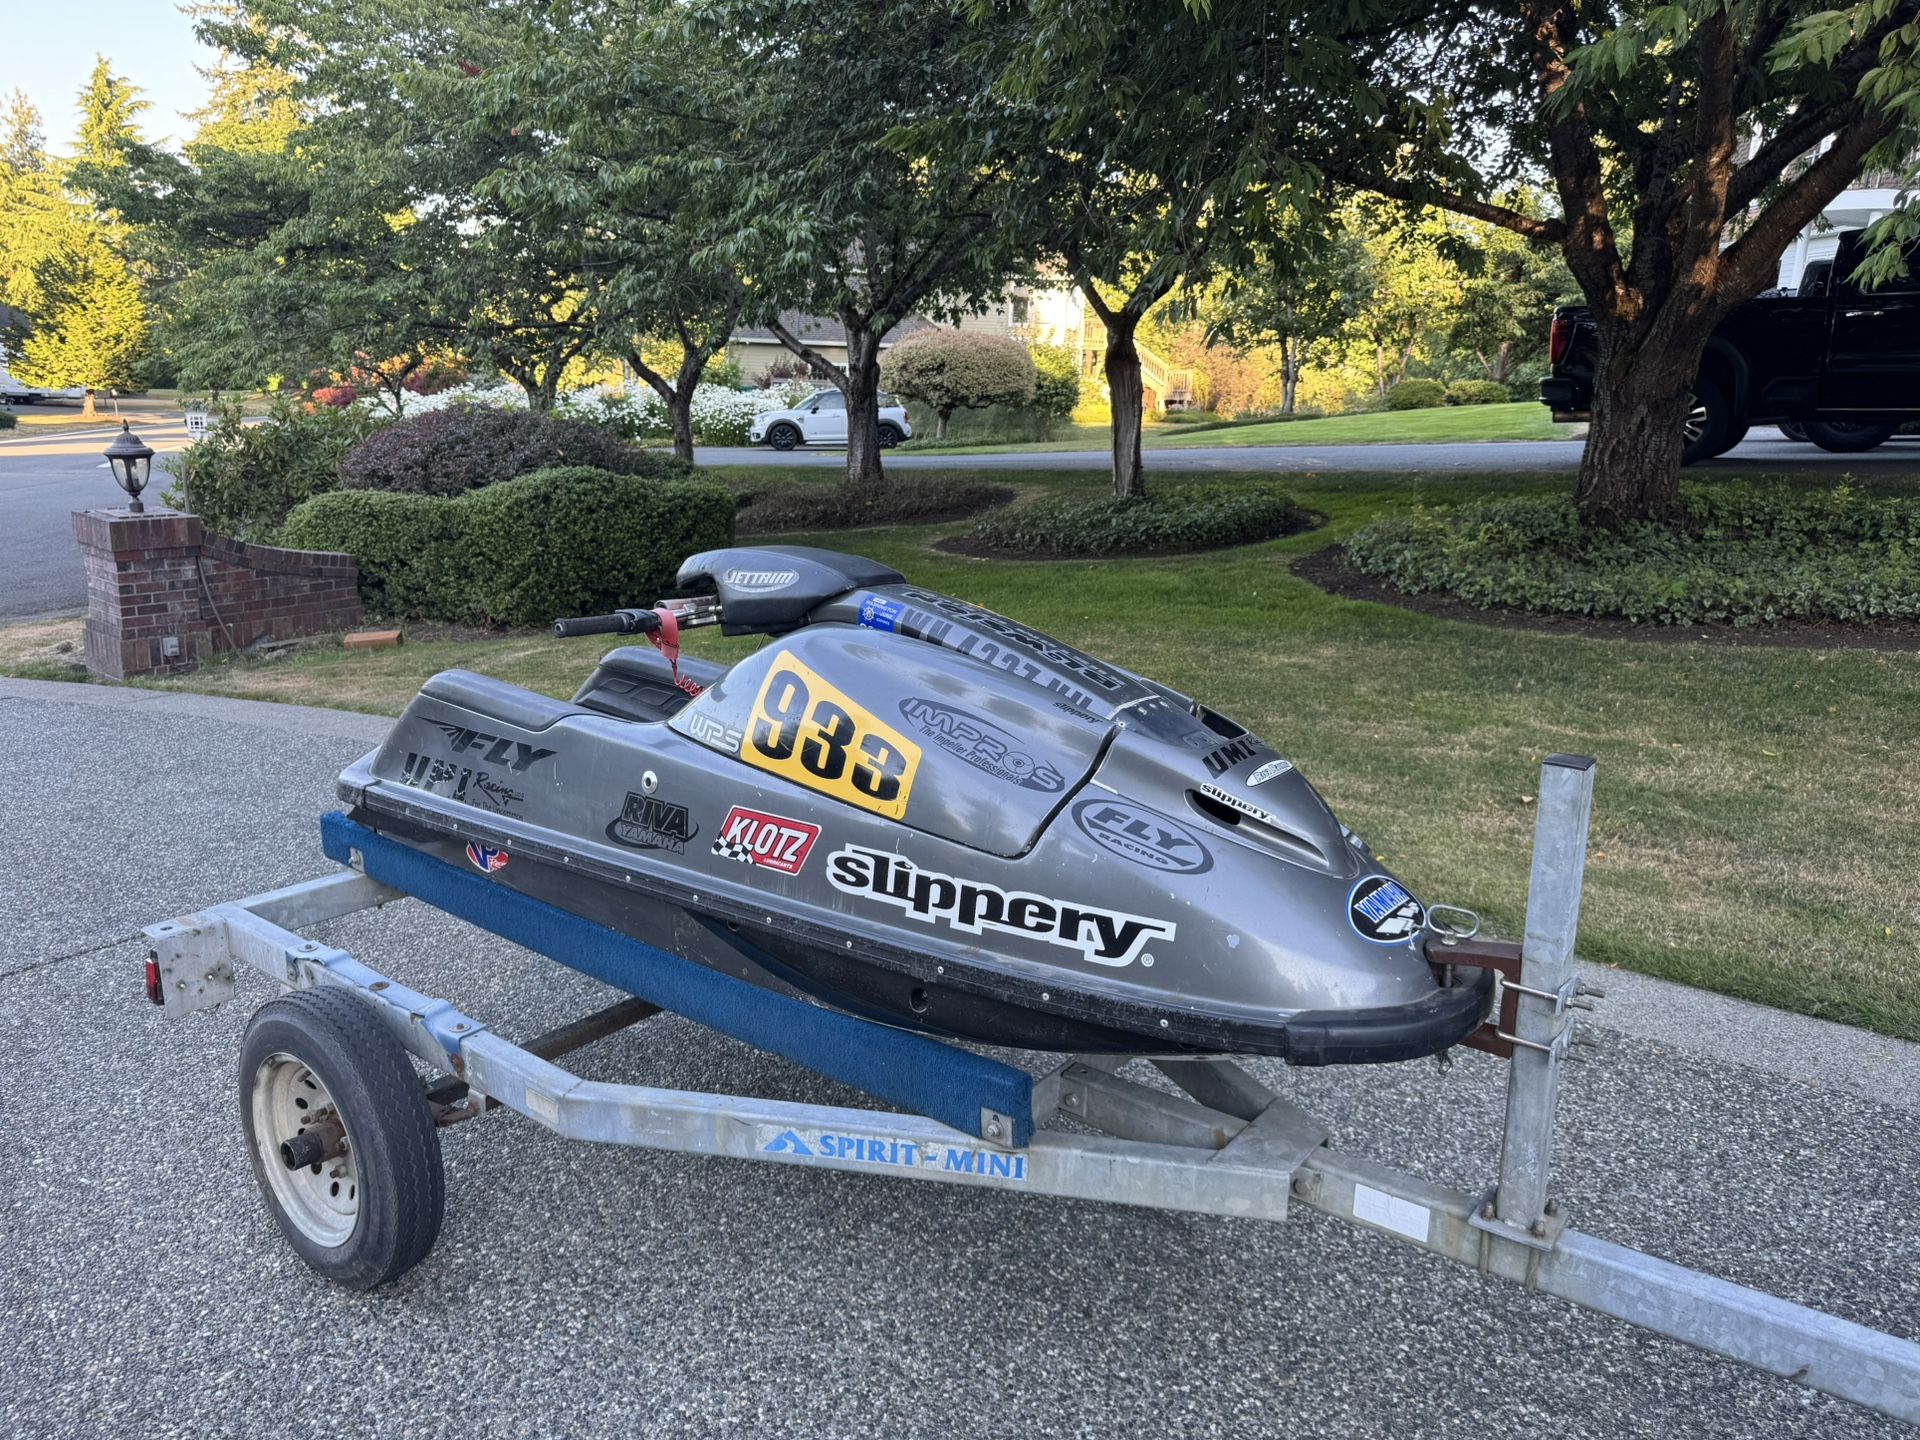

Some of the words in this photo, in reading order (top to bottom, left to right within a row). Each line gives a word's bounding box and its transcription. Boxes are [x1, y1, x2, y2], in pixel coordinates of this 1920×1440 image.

[725, 571, 794, 584] JETTRIM
[450, 727, 558, 772] FLY
[690, 714, 743, 753] WPS
[752, 669, 907, 801] 933
[918, 725, 935, 739] The
[933, 733, 967, 755] Impeller
[964, 751, 1024, 785] Professionals
[1202, 740, 1257, 779] UMI
[473, 771, 518, 804] Racing
[1201, 784, 1273, 820] slippery
[623, 792, 689, 839] RIVA
[1092, 807, 1196, 850] FLY
[620, 823, 685, 856] YAMAHA
[726, 816, 809, 863] KLOTZ
[1098, 832, 1169, 865] RACING
[832, 848, 1166, 959] slippery
[1353, 881, 1410, 924] YAMAHA
[819, 1134, 919, 1166] SPIRIT
[945, 1148, 1024, 1179] MINI
